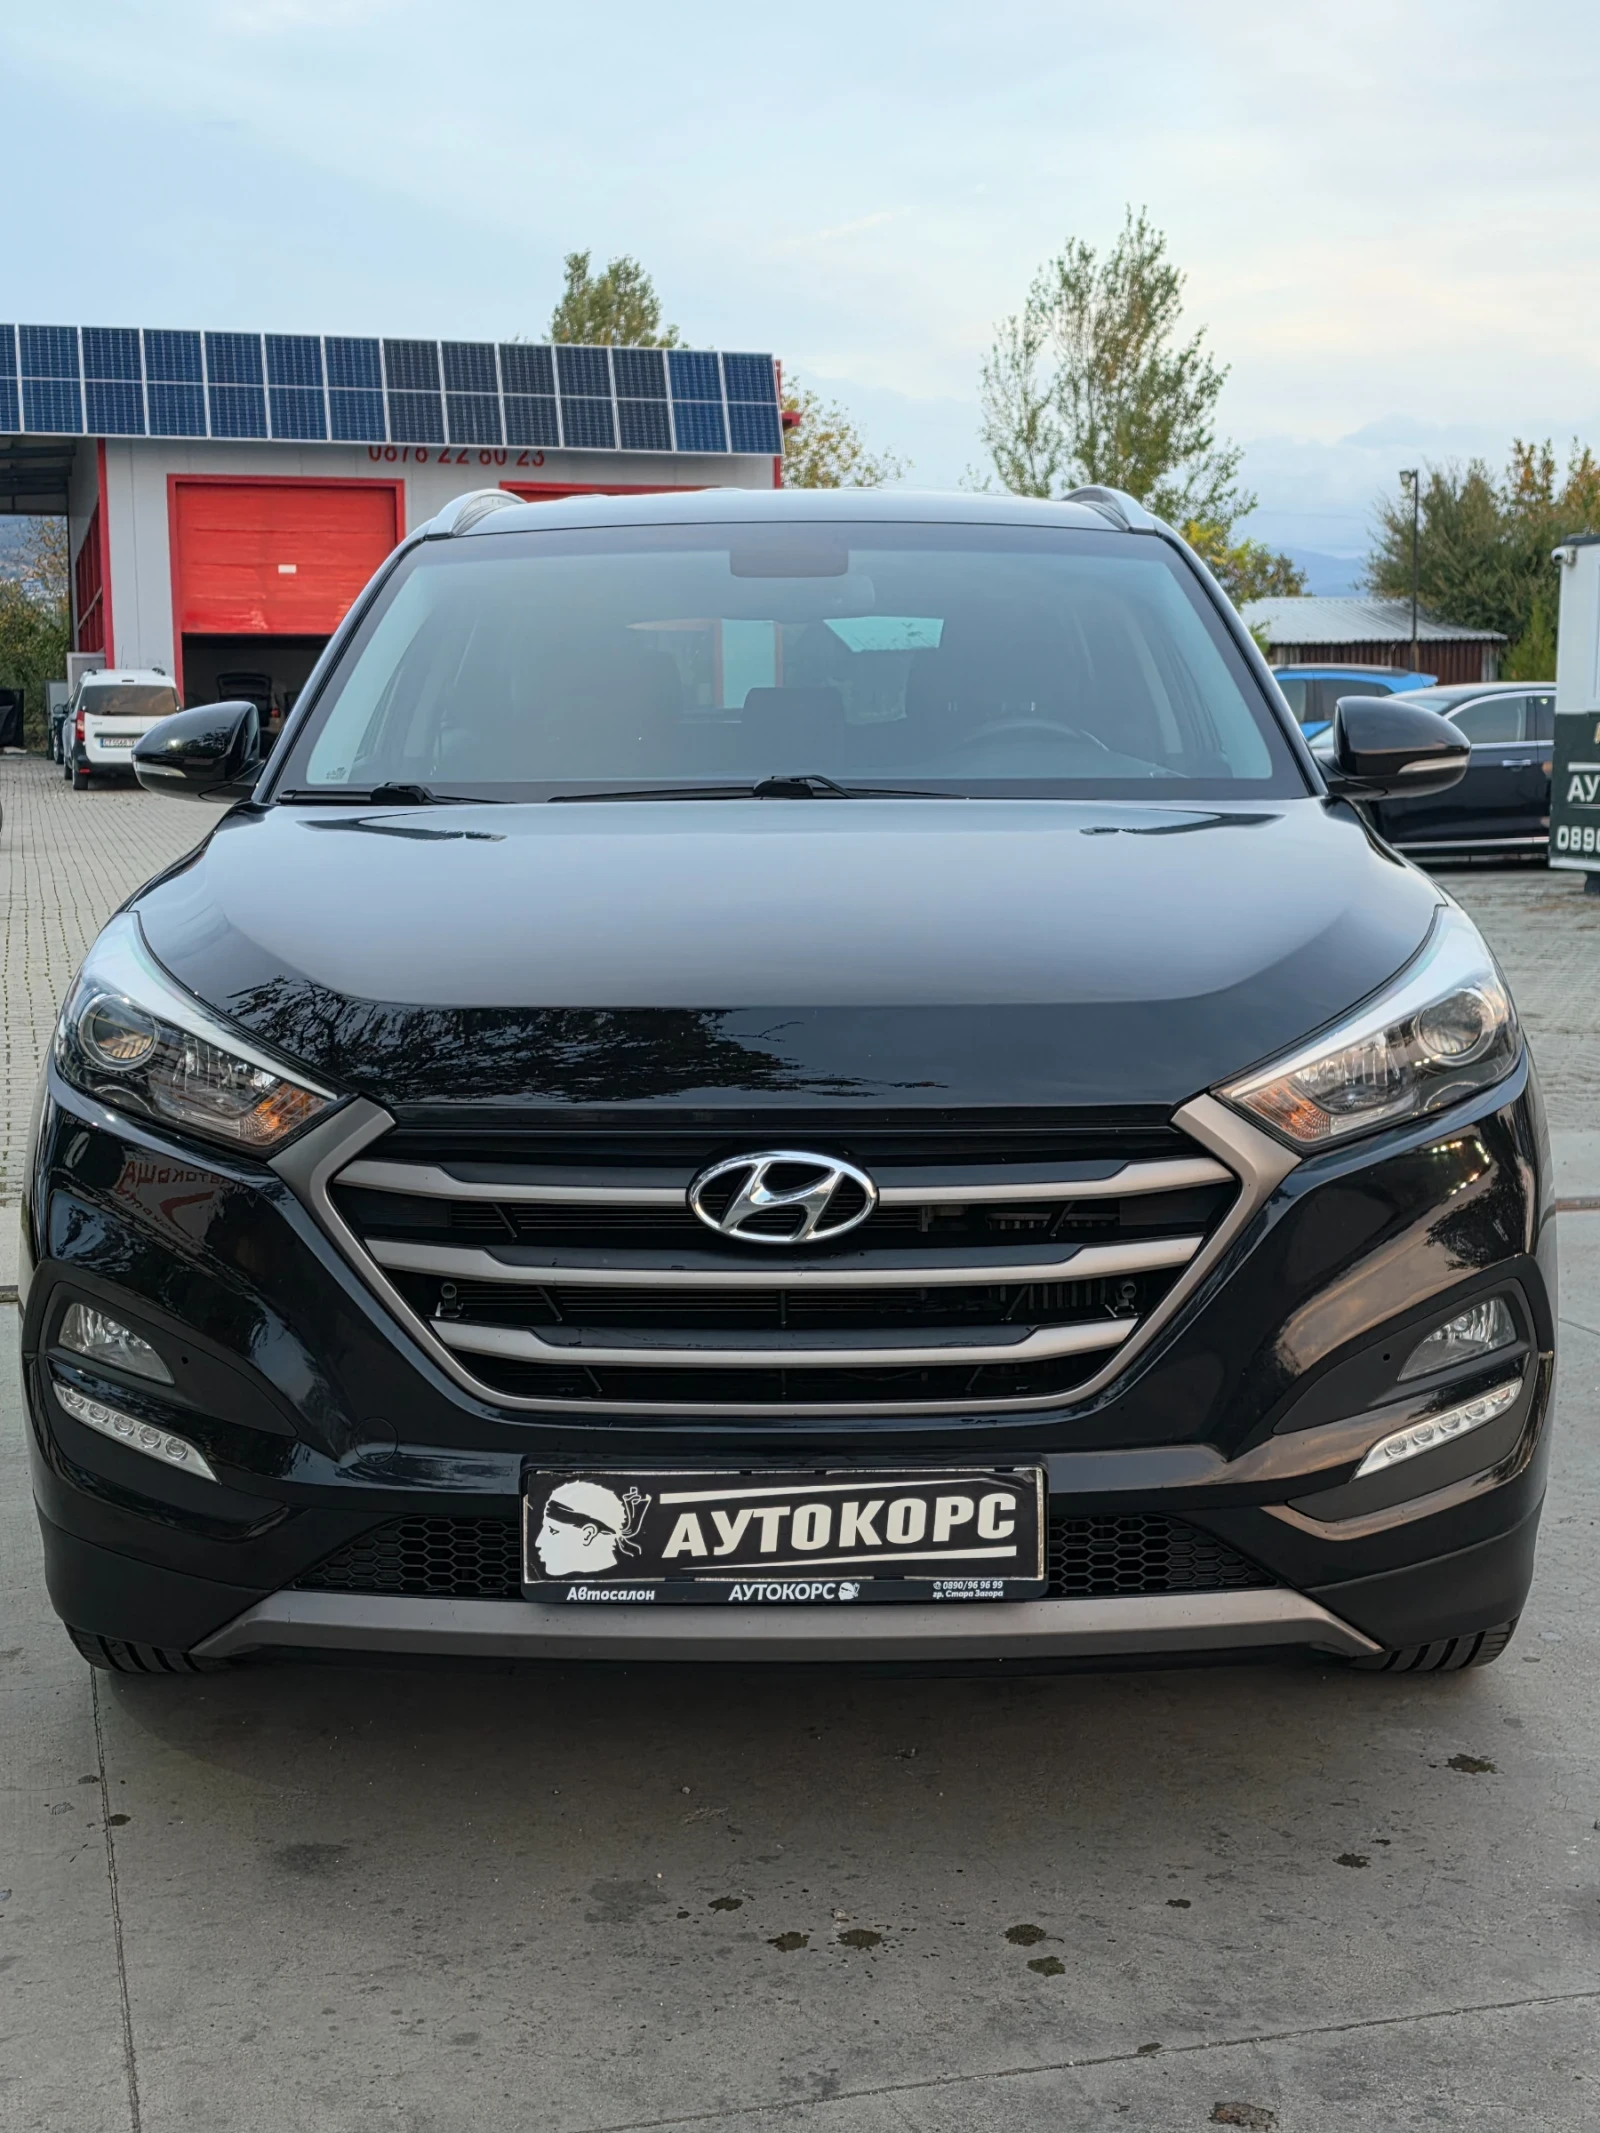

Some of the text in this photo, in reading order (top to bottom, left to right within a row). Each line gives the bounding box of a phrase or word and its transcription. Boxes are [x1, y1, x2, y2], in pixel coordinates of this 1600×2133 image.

[1566, 775, 1600, 802] АУ
[661, 1492, 1017, 1559] АУТОКОРС
[727, 1582, 836, 1601] АУТОКОРС
[980, 1581, 990, 1589] 96
[566, 1586, 656, 1602] Автосалон
[946, 1590, 973, 1598] Стара
[975, 1590, 1003, 1598] Загора
